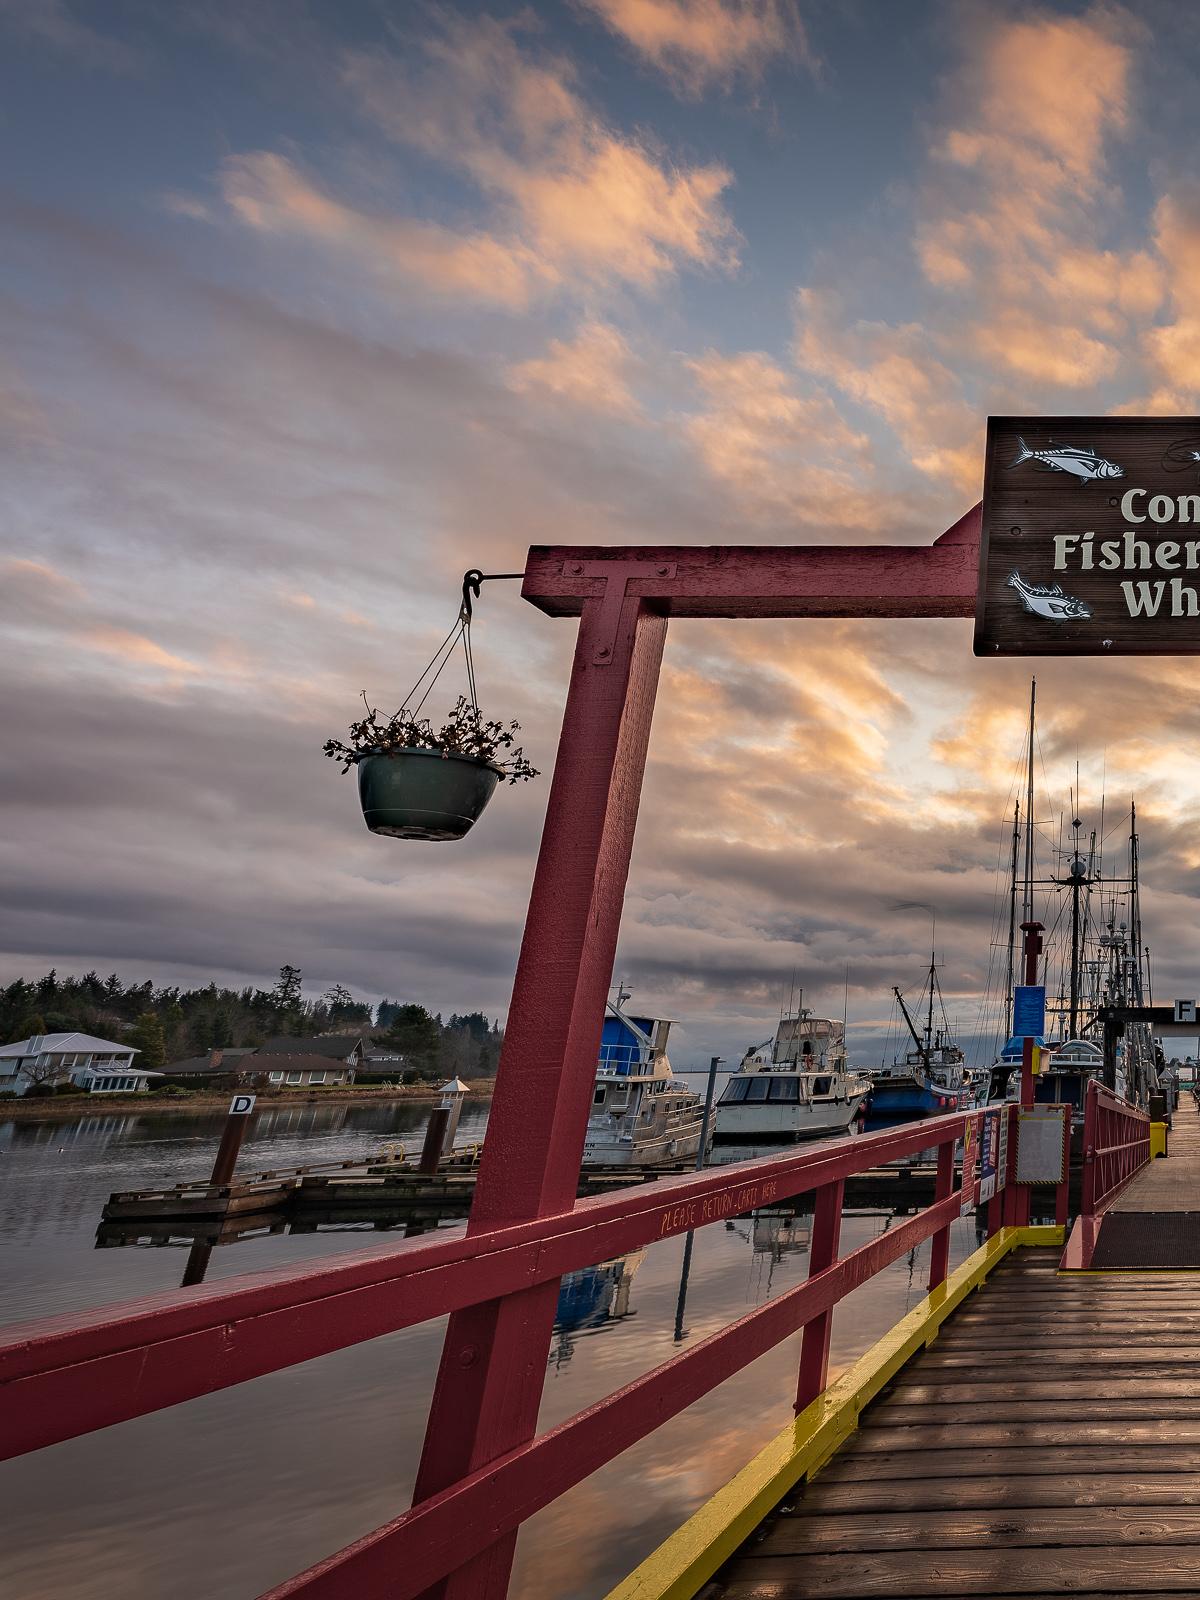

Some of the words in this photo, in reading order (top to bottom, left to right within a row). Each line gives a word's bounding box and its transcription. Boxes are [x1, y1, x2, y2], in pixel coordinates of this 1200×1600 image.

[1178, 1001, 1192, 1020] F
[232, 1097, 251, 1112] D
[660, 1203, 697, 1235] PLEASE
[701, 1192, 734, 1221] RETURN
